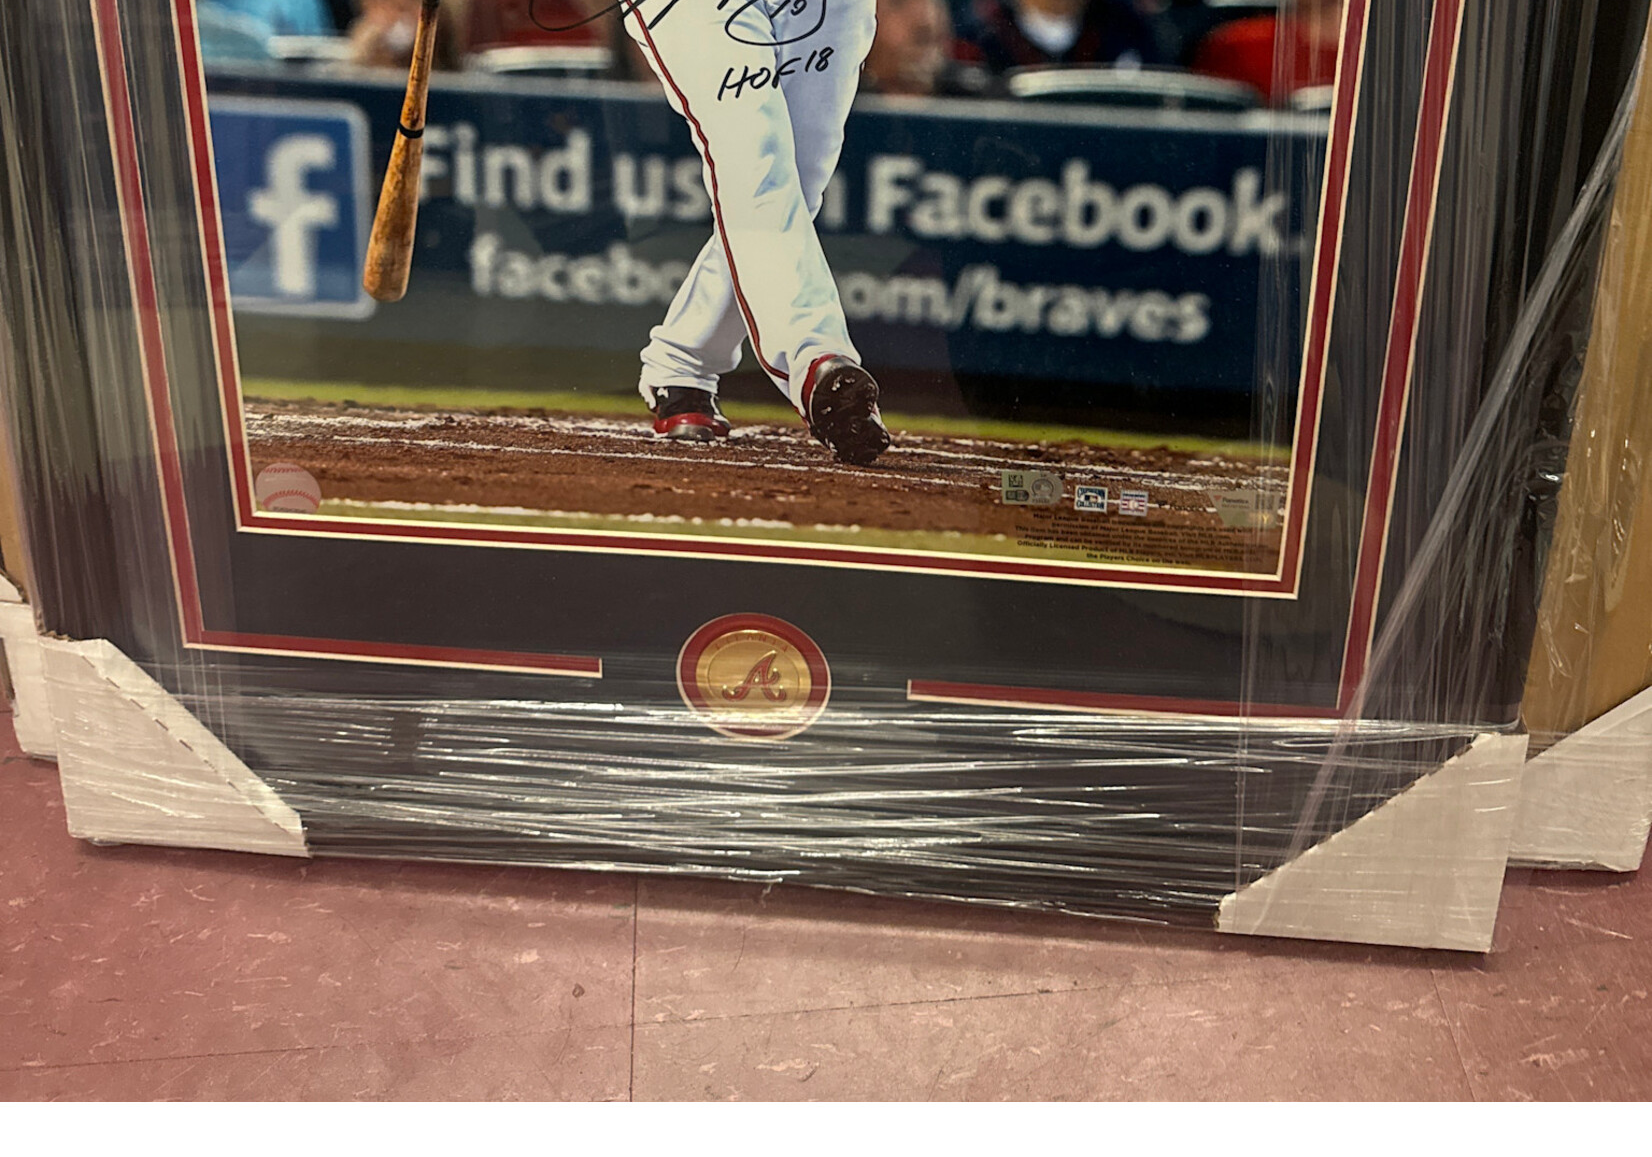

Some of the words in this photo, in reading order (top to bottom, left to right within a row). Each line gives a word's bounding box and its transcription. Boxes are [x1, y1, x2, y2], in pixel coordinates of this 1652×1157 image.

[716, 56, 804, 102] HOF
[804, 47, 835, 74] 18
[420, 122, 594, 214] Find
[611, 153, 706, 220] us
[721, 649, 788, 702] A
